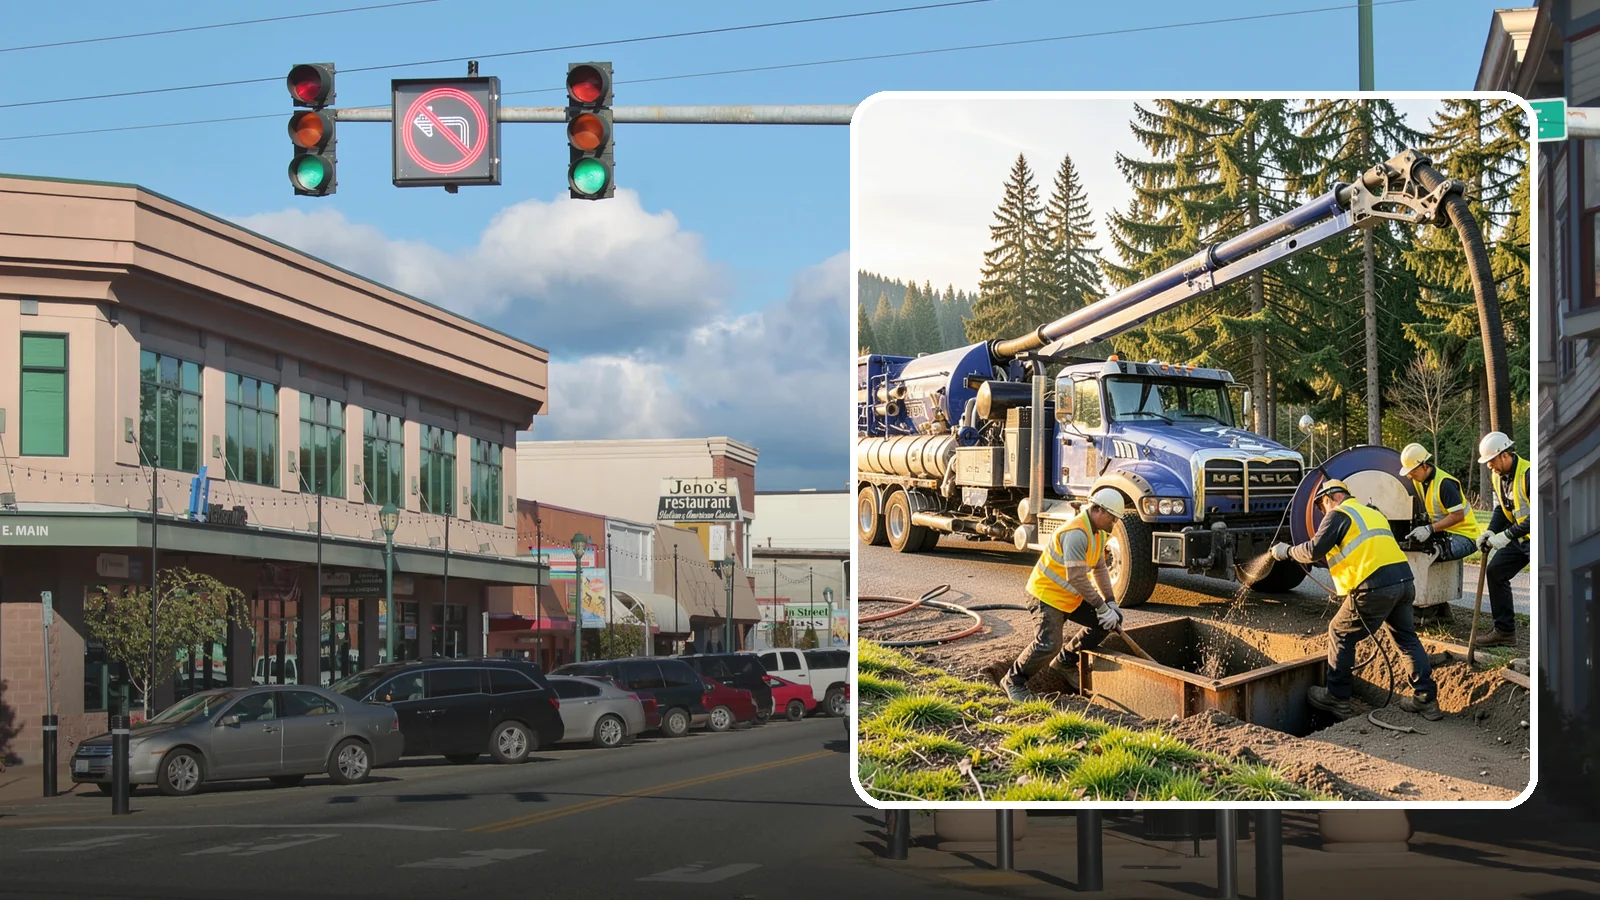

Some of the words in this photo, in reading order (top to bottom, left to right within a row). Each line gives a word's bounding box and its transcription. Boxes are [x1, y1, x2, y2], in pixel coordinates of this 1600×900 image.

[670, 480, 727, 495] Jeno's
[665, 496, 731, 509] restaurant
[659, 510, 681, 519] Italian
[686, 510, 714, 519] American
[715, 510, 737, 519] Cuisine
[2, 525, 13, 536] E.
[15, 525, 49, 536] MAIN
[797, 607, 829, 617] Street
[791, 619, 824, 627] lass
